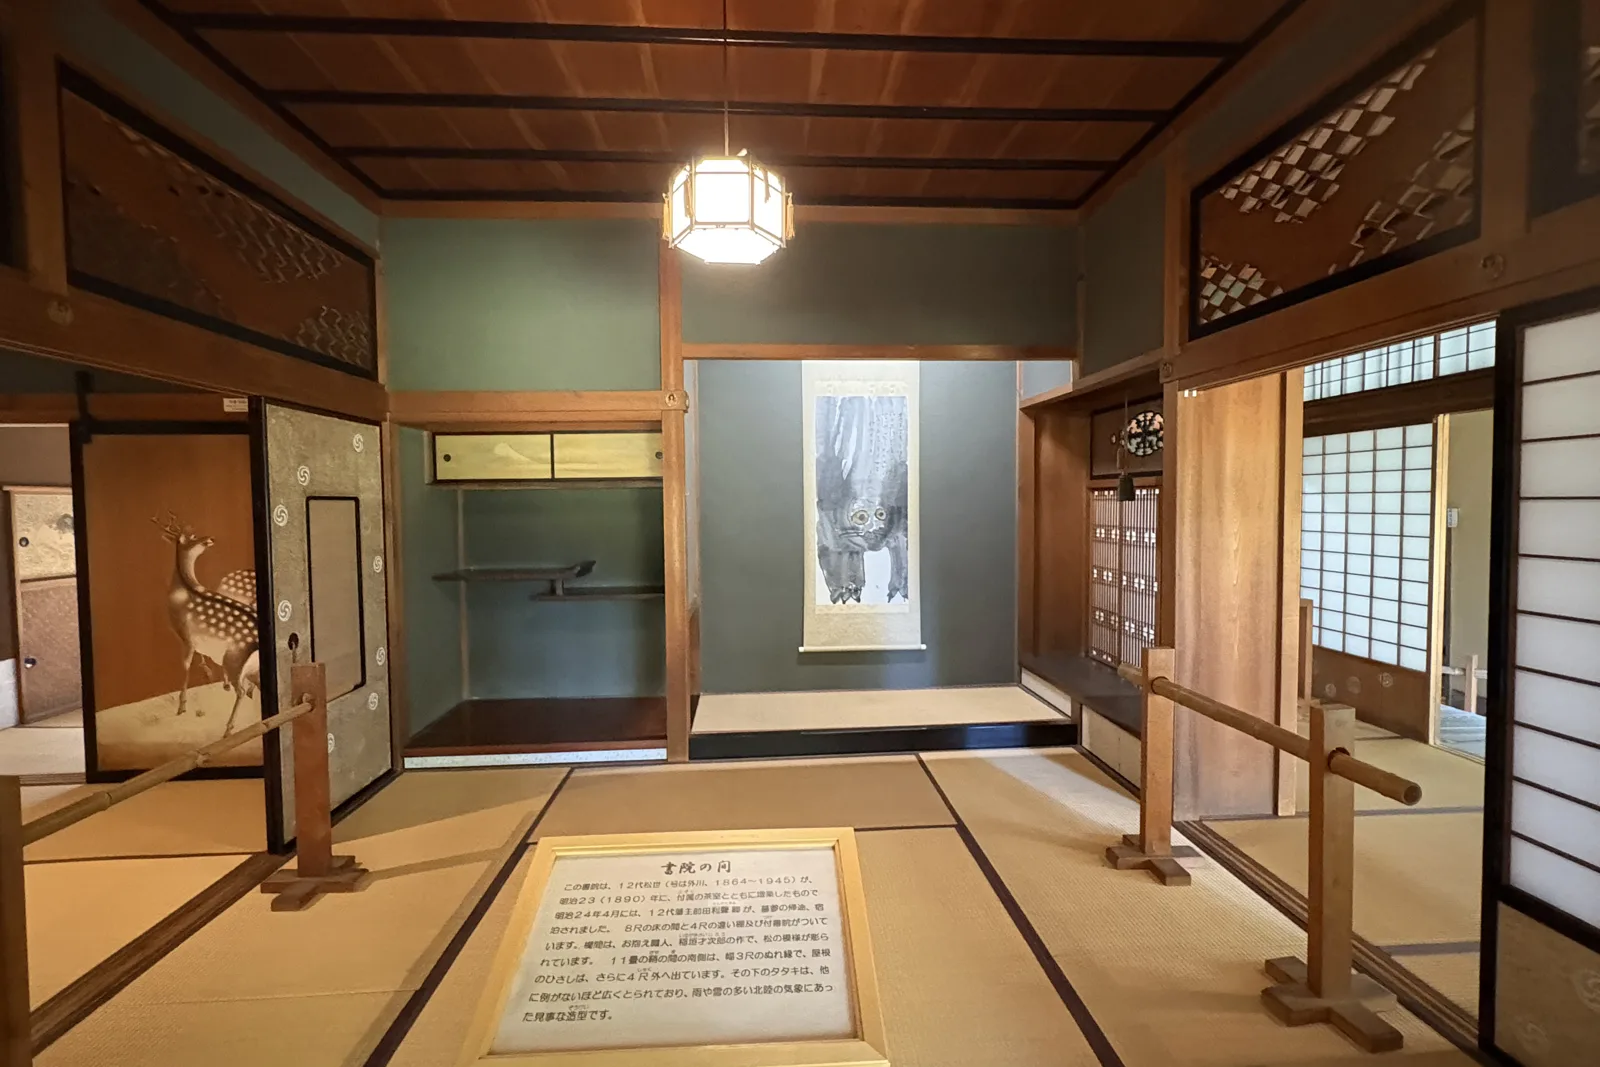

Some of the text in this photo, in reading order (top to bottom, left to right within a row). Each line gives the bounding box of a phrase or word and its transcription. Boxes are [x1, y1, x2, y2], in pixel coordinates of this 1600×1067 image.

[661, 860, 731, 875] 書院の間
[522, 1009, 613, 1022] た見事な造型です。
